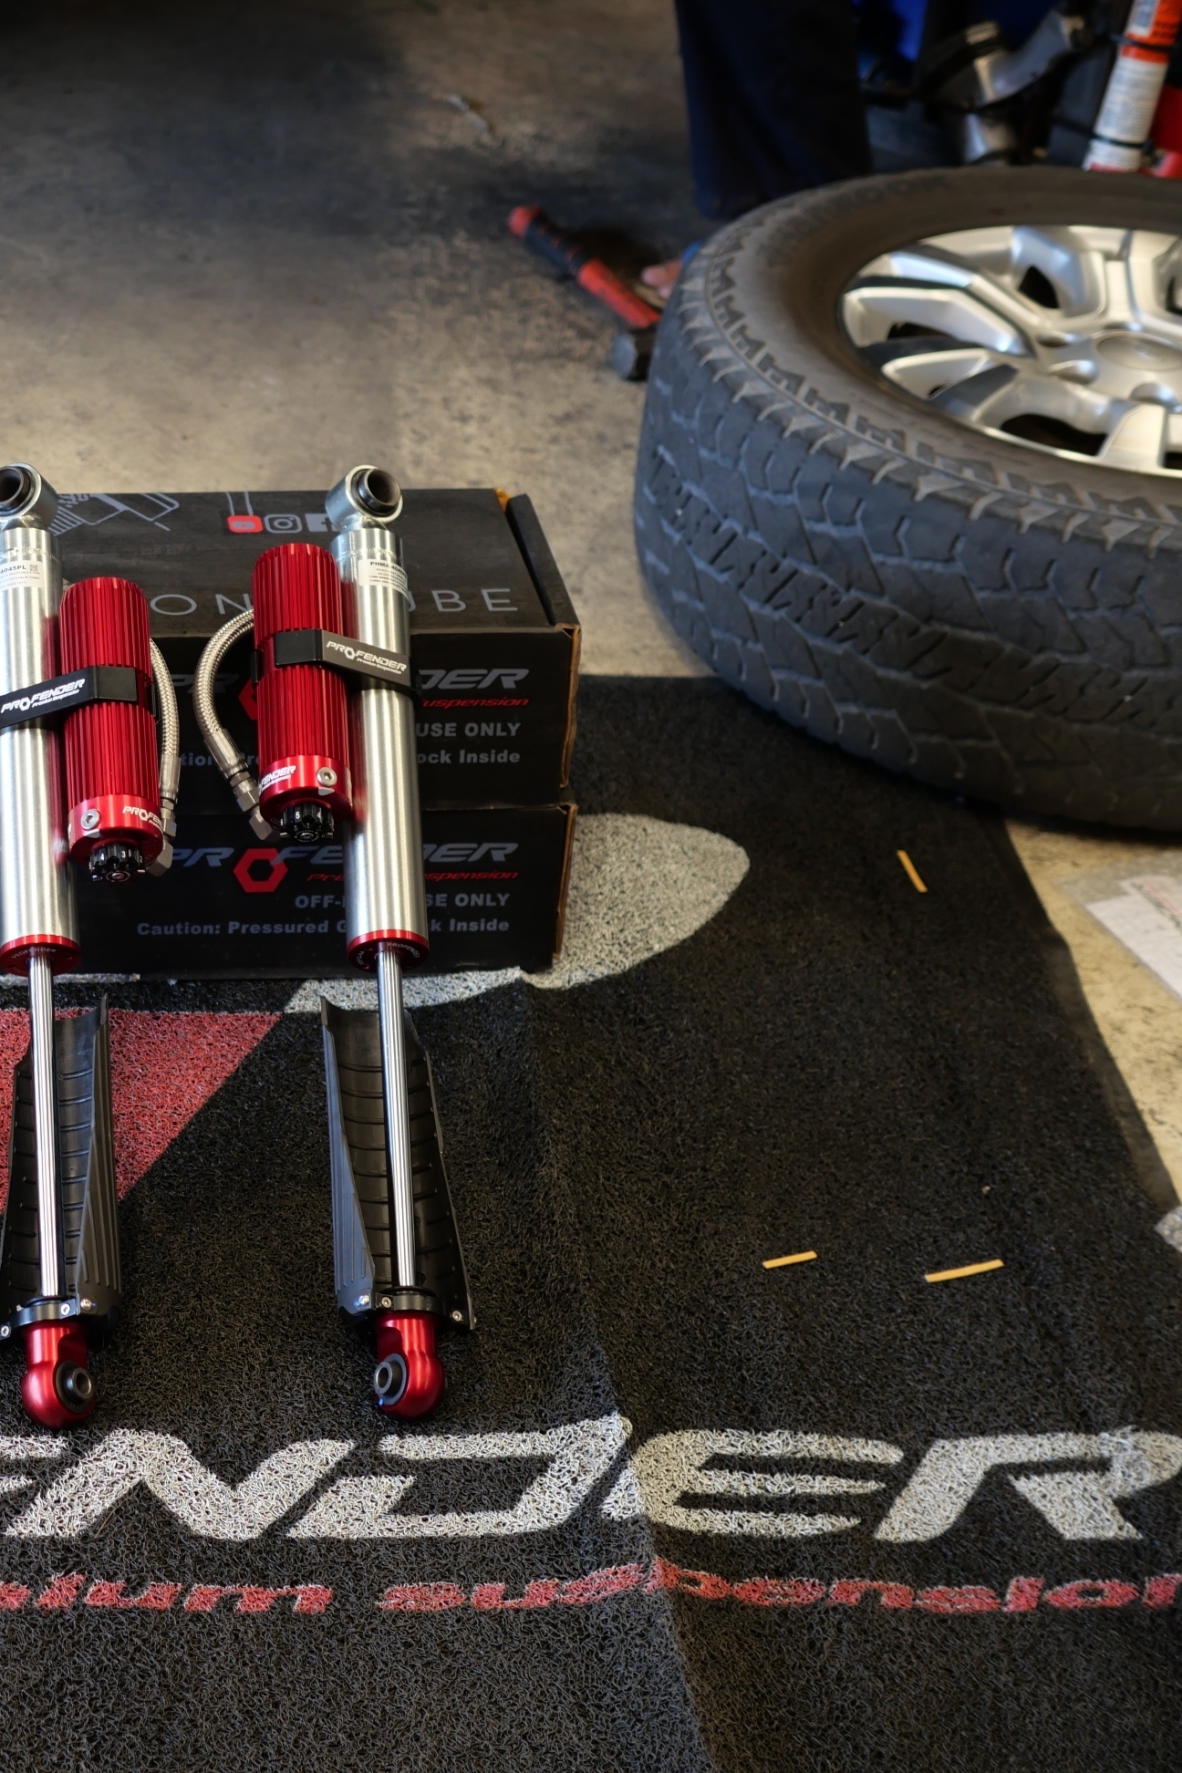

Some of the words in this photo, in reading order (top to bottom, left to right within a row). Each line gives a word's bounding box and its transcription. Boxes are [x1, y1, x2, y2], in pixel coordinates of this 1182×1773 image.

[326, 641, 407, 672] PROFENDER
[0, 678, 85, 714] PROFENDER
[421, 696, 530, 710] uspension
[416, 722, 457, 737] USE
[464, 722, 521, 737] ONLY
[417, 749, 451, 764] ock
[459, 749, 521, 764] Inside
[426, 893, 447, 908] SE
[454, 893, 510, 908] ONLY
[137, 921, 220, 936] Caution:
[228, 919, 329, 935] Pressured
[449, 918, 510, 933] Inside
